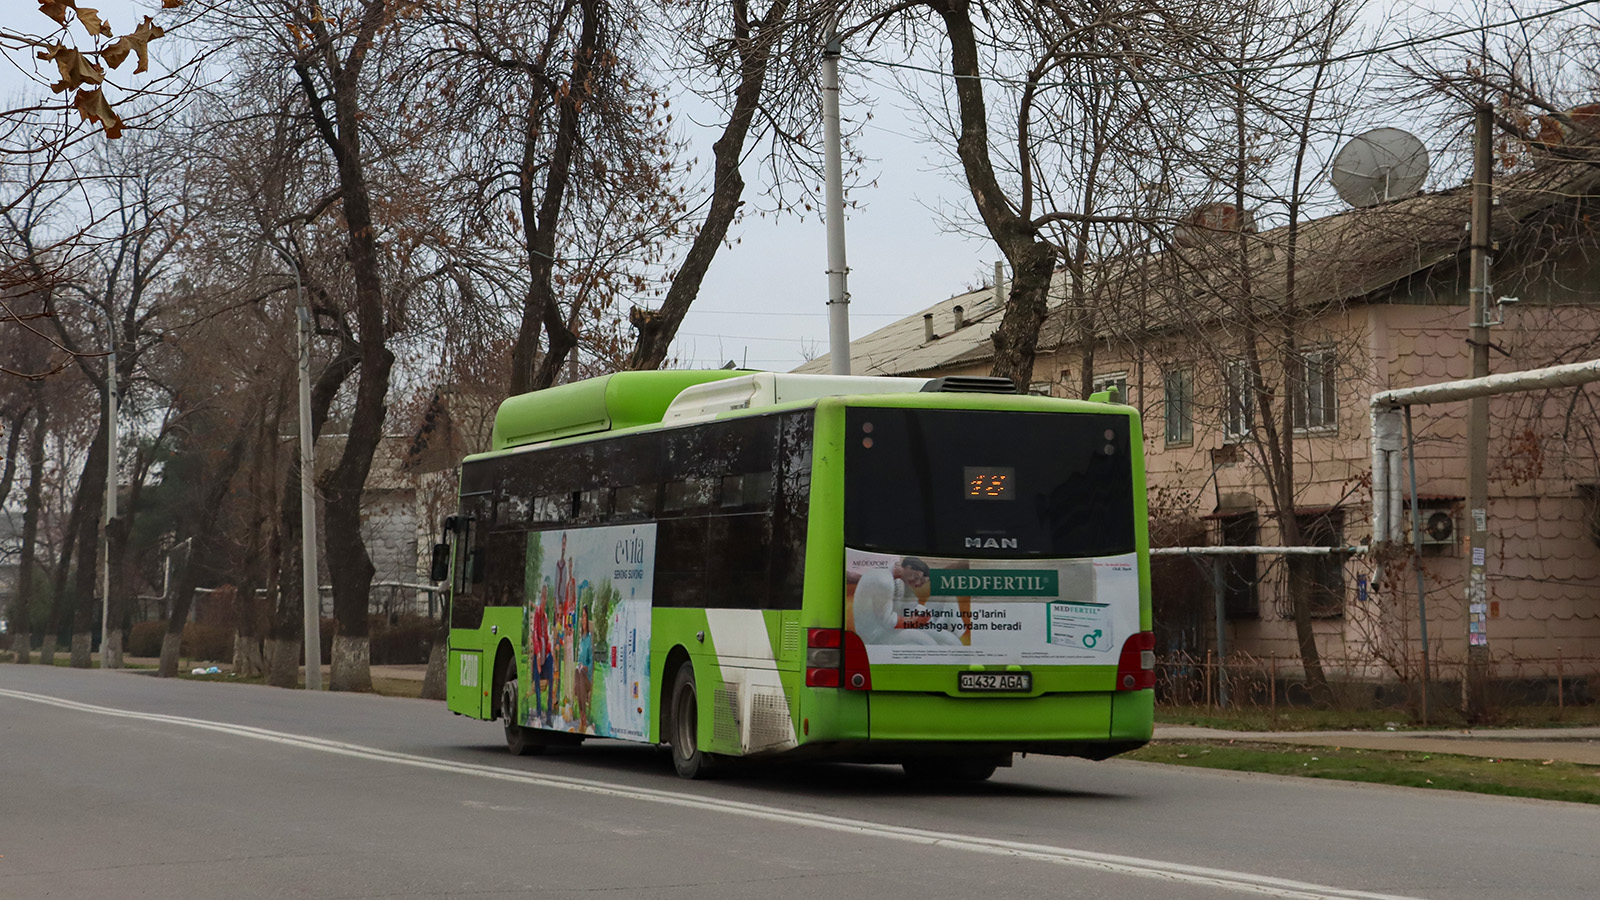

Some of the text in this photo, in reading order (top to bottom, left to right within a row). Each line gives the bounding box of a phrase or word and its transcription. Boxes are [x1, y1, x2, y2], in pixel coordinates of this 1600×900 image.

[965, 537, 1018, 549] MAN
[903, 608, 1006, 620] Erkaklarni urug'larini
[903, 621, 1022, 632] tiklashga yordam beradi
[975, 676, 996, 688] 432
[1000, 676, 1024, 688] AGA
